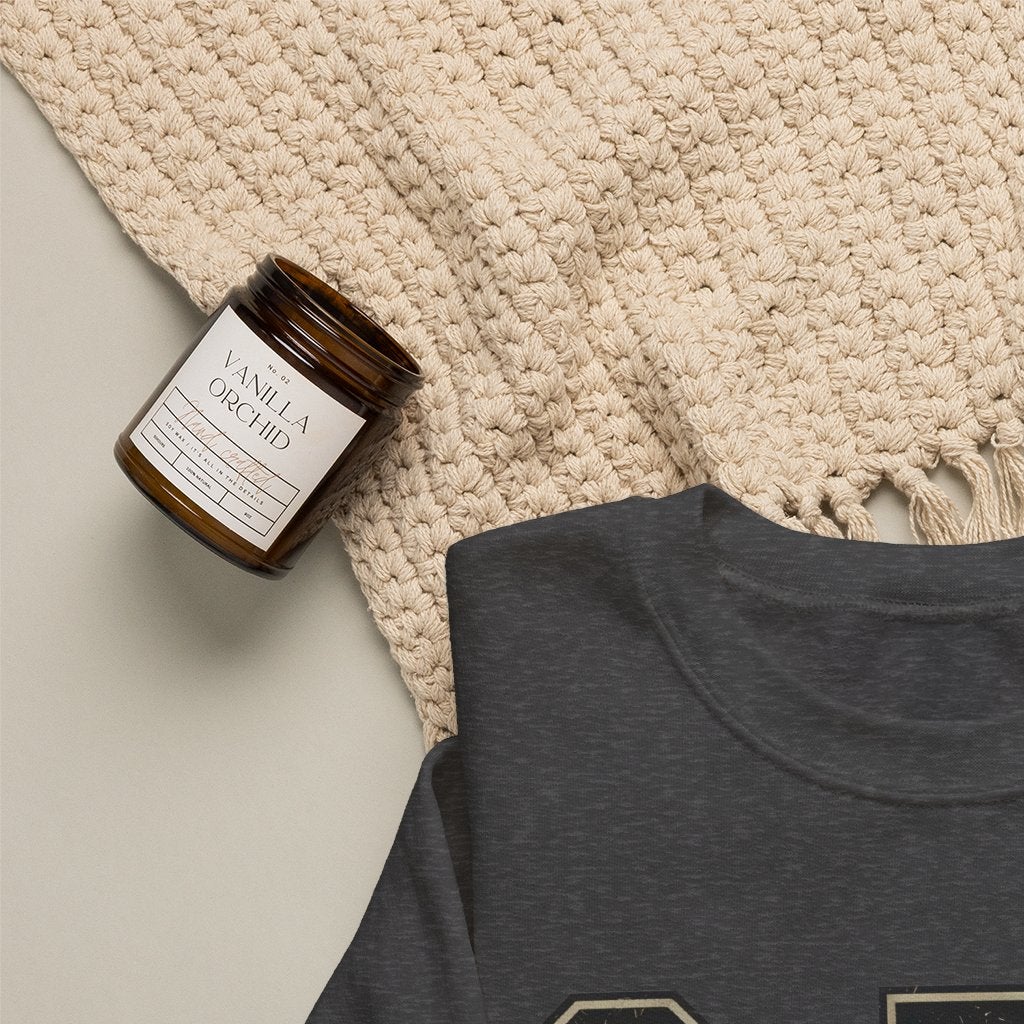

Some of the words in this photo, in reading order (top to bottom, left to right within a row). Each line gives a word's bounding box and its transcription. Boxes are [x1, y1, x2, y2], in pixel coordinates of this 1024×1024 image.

[224, 349, 309, 434] VANILLA
[267, 364, 279, 377] No.
[280, 375, 291, 385] 02
[209, 377, 290, 450] ORCHID
[203, 457, 215, 469] ALL
[215, 467, 224, 476] IN
[225, 475, 237, 486] THE
[238, 485, 264, 506] DETAILS
